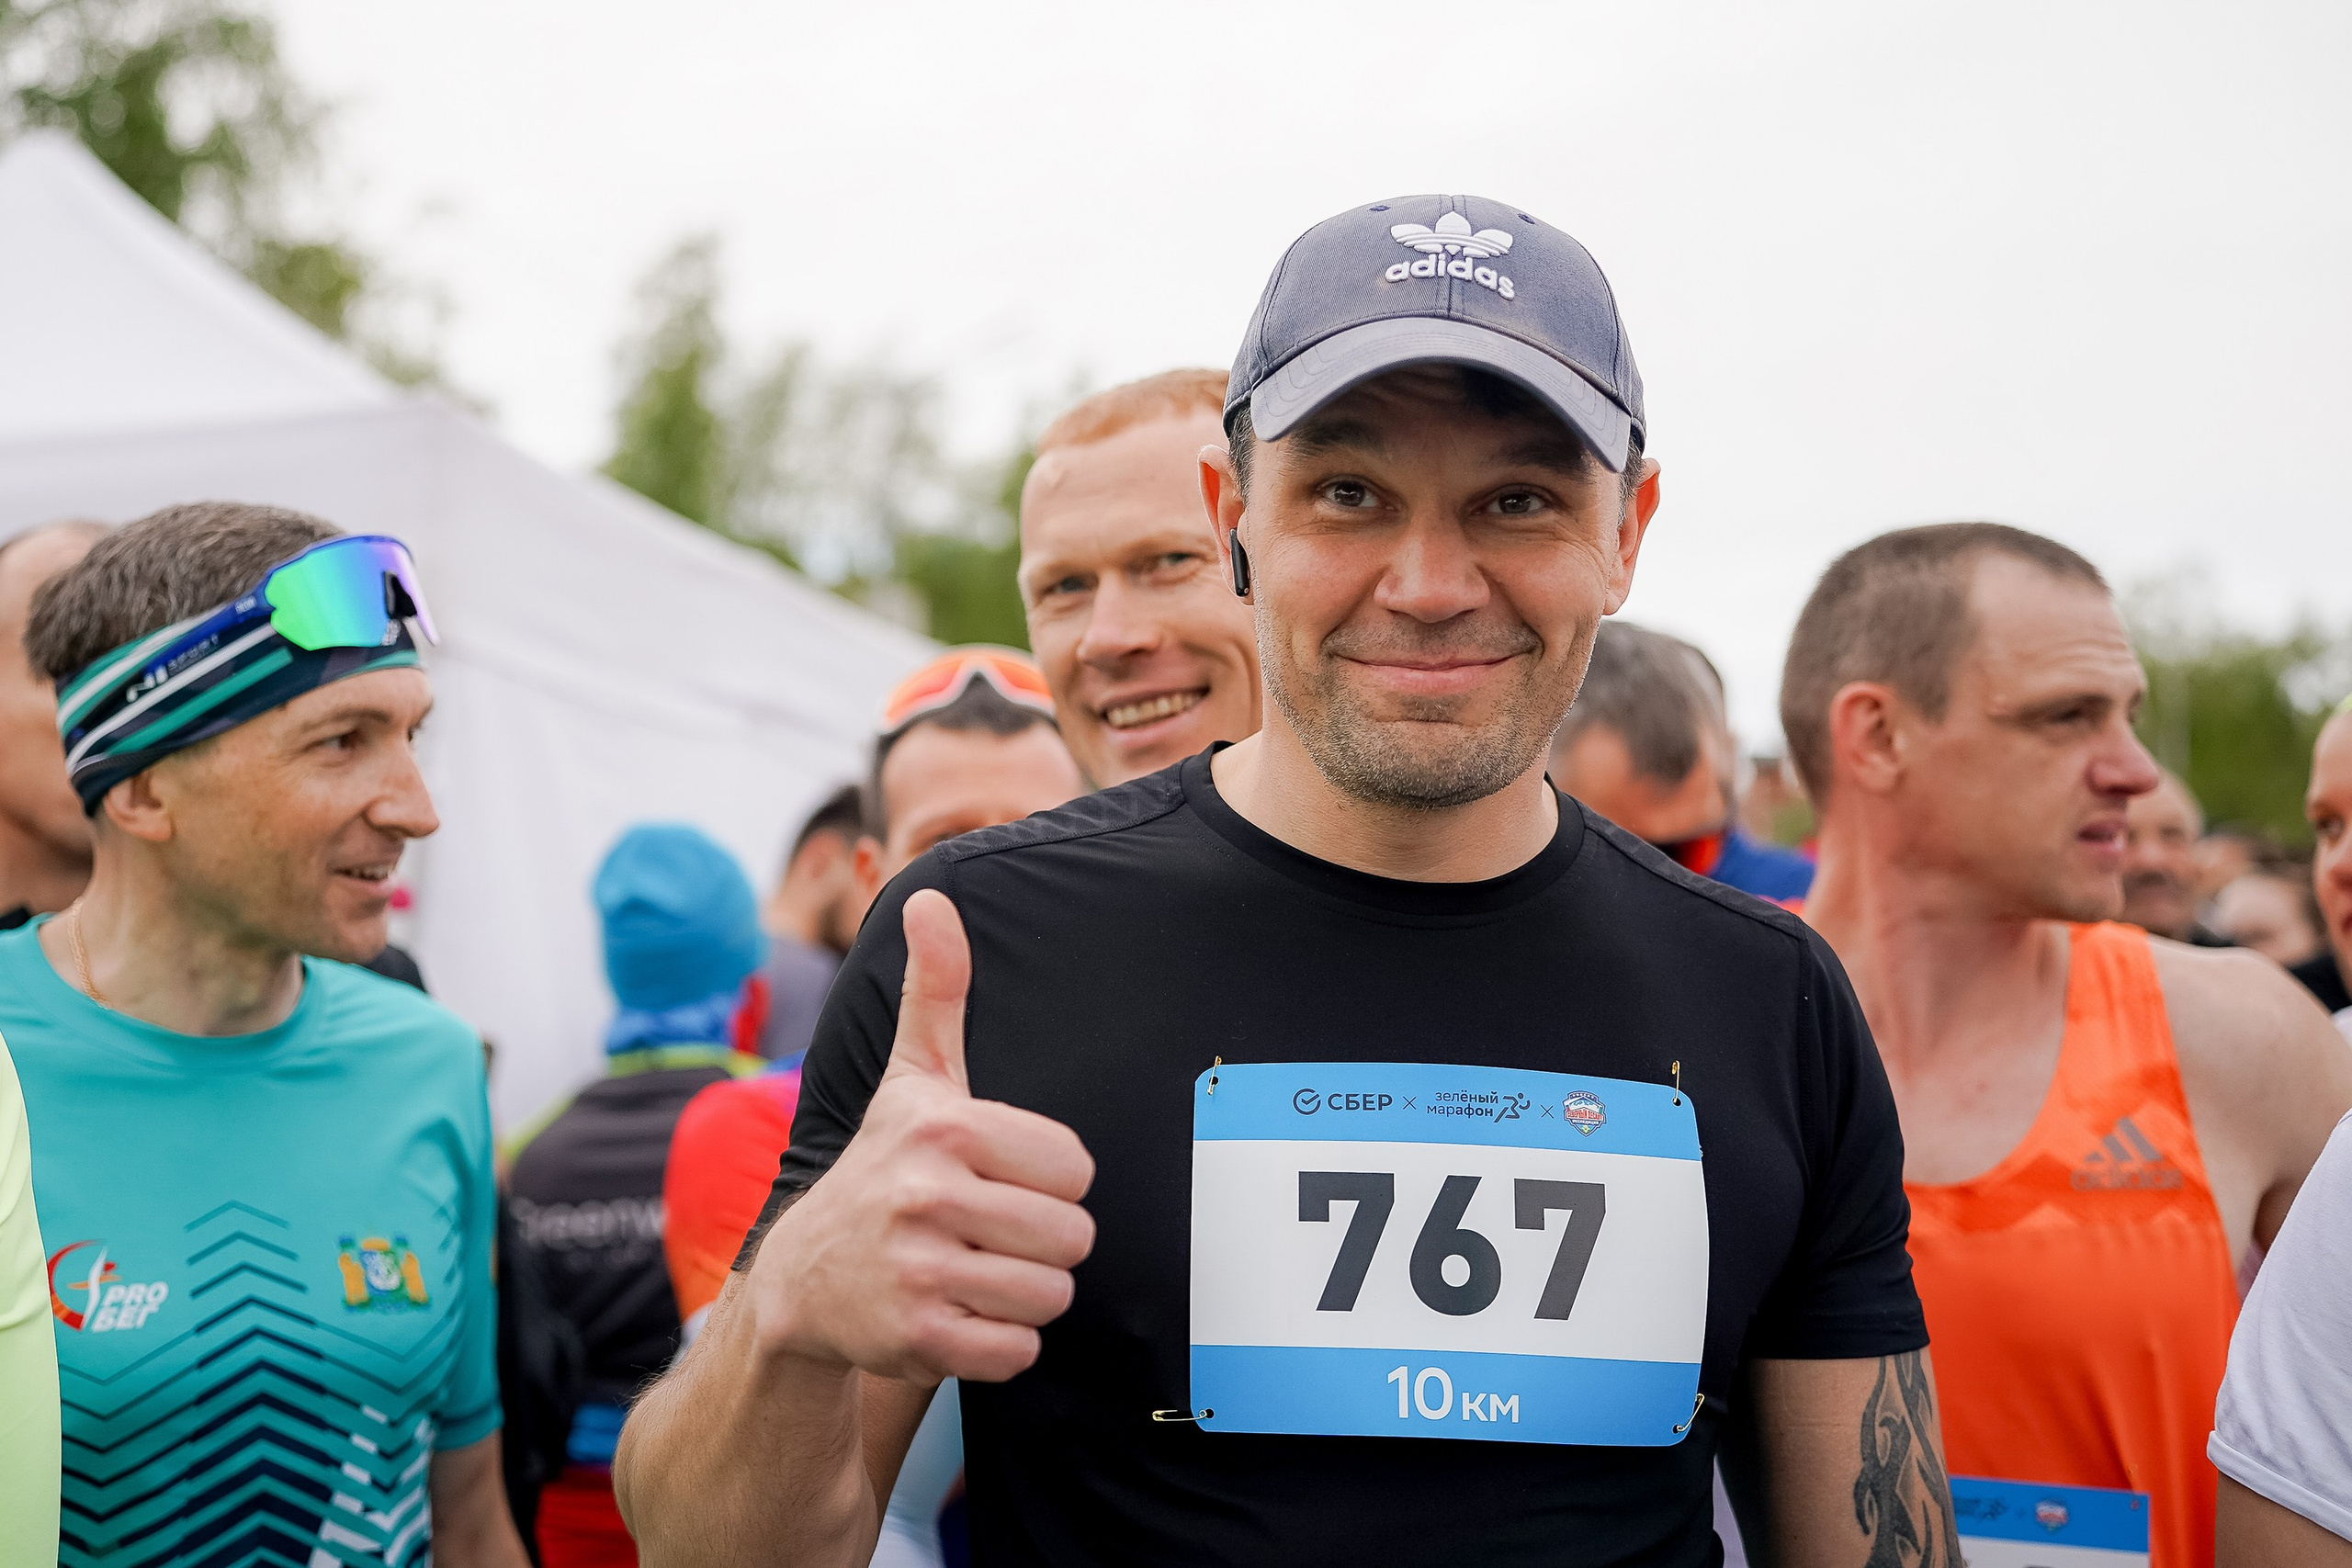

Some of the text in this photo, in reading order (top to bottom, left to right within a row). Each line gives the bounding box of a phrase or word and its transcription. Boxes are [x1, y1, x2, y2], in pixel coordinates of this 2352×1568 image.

[1385, 253, 1515, 301] adidas
[1328, 1093, 1393, 1111] СБЕР
[1434, 1089, 1498, 1104] зелёный
[1427, 1103, 1494, 1119] марафон
[1298, 1170, 1607, 1321] 767
[102, 1281, 169, 1308] PRO
[91, 1303, 159, 1333] БЕГ
[1387, 1365, 1453, 1420] 10
